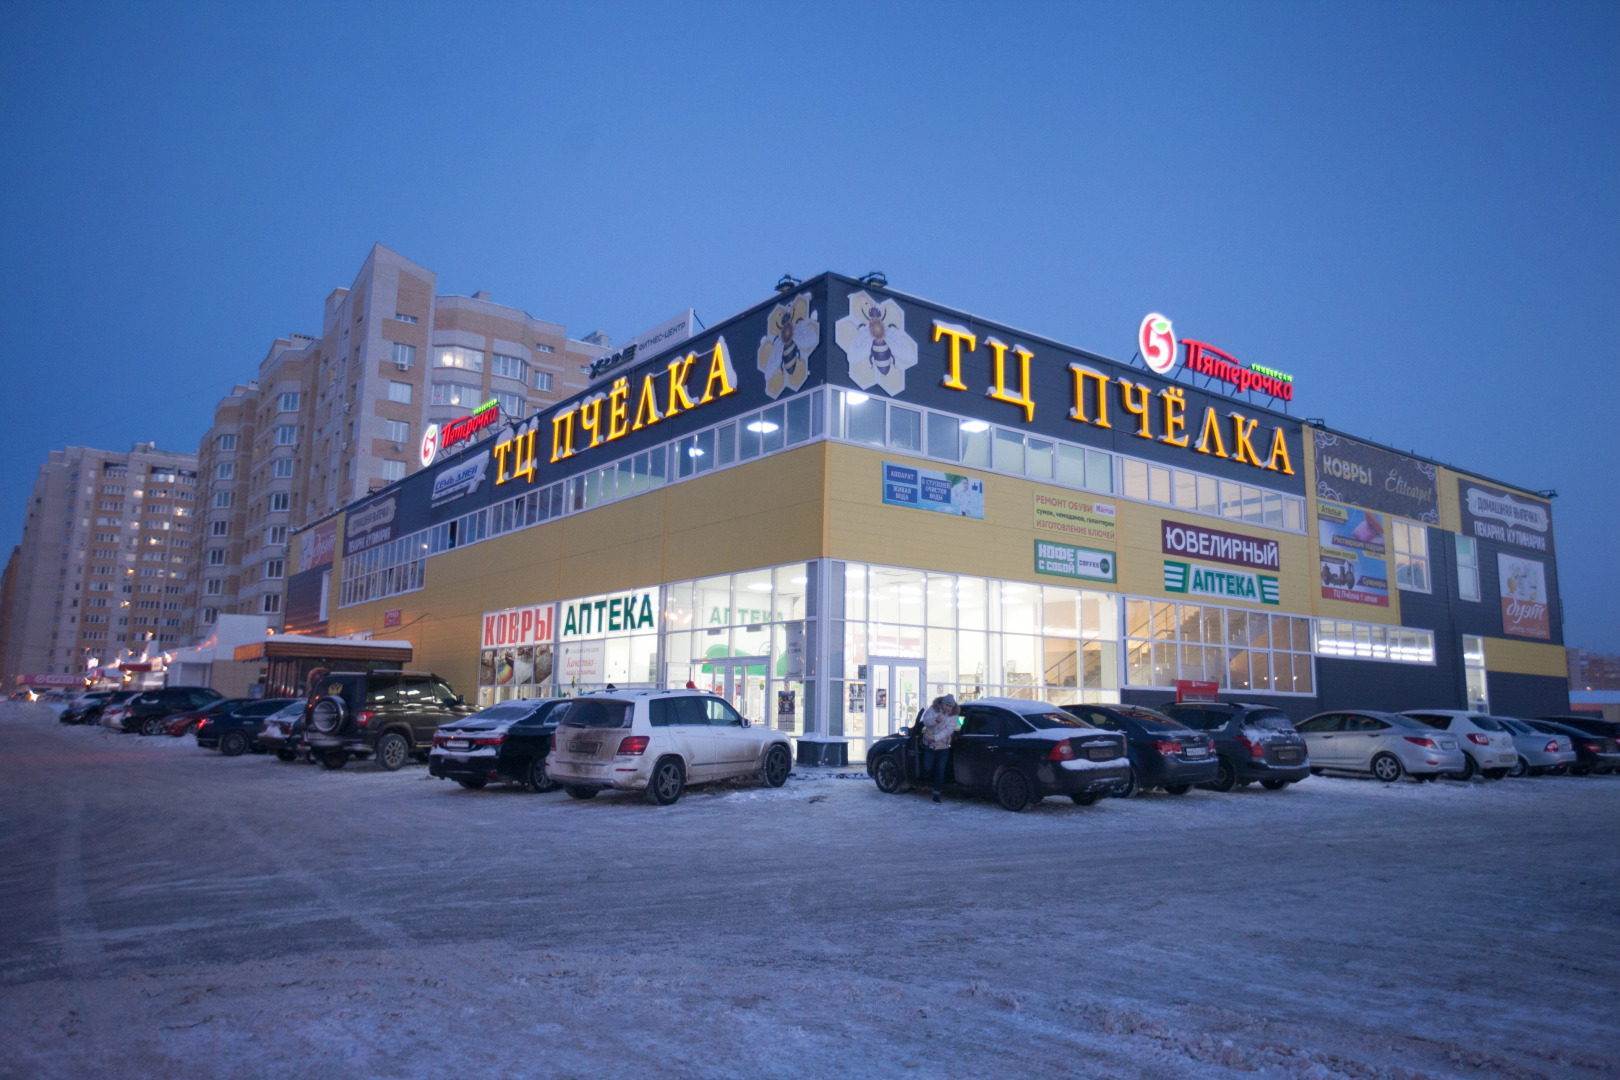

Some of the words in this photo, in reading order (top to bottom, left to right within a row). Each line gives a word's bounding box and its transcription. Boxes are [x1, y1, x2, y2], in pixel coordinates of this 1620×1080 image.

[638, 321, 686, 351] ФИТНЕС-ЦЕНТР
[933, 323, 1035, 422] ТЦ
[1068, 364, 1295, 476] ПЧЁЛКА
[494, 429, 538, 486] ТЦ
[549, 342, 737, 464] ПЧЁЛКА
[434, 477, 455, 491] СЕМЬ
[456, 465, 479, 482] ДНЕЙ
[890, 470, 914, 480] АППАРАТ
[1322, 454, 1372, 486] КОВРЫ
[892, 485, 912, 495] ЖИВАЯ
[925, 486, 947, 495] ОЧИСТКИ
[926, 480, 951, 489] СТУПЕНЕЙ
[895, 493, 909, 501] ВОДА
[929, 493, 943, 501] ВОДЫ
[1036, 494, 1066, 509] РЕМОНТ
[1068, 501, 1093, 513] ОБУВИ
[1036, 508, 1055, 518] сумок,
[1056, 512, 1086, 523] чемоданов,
[1321, 505, 1342, 517] Ателье
[1036, 520, 1087, 536] ИЗГОТОВЛЕНИЕ
[1087, 529, 1115, 540] КЛЮЧЕЙ
[1165, 526, 1279, 567] ЮВЕЛИРНЫЙ
[1506, 528, 1545, 552] КУЛИНАРИЯ
[1039, 559, 1045, 570] С
[1046, 560, 1075, 574] СОБОЙ
[1078, 560, 1100, 569] COFFEE
[1192, 567, 1257, 599] АПТЕКА
[563, 594, 654, 636] АПТЕКА
[484, 606, 553, 646] КОВРЫ
